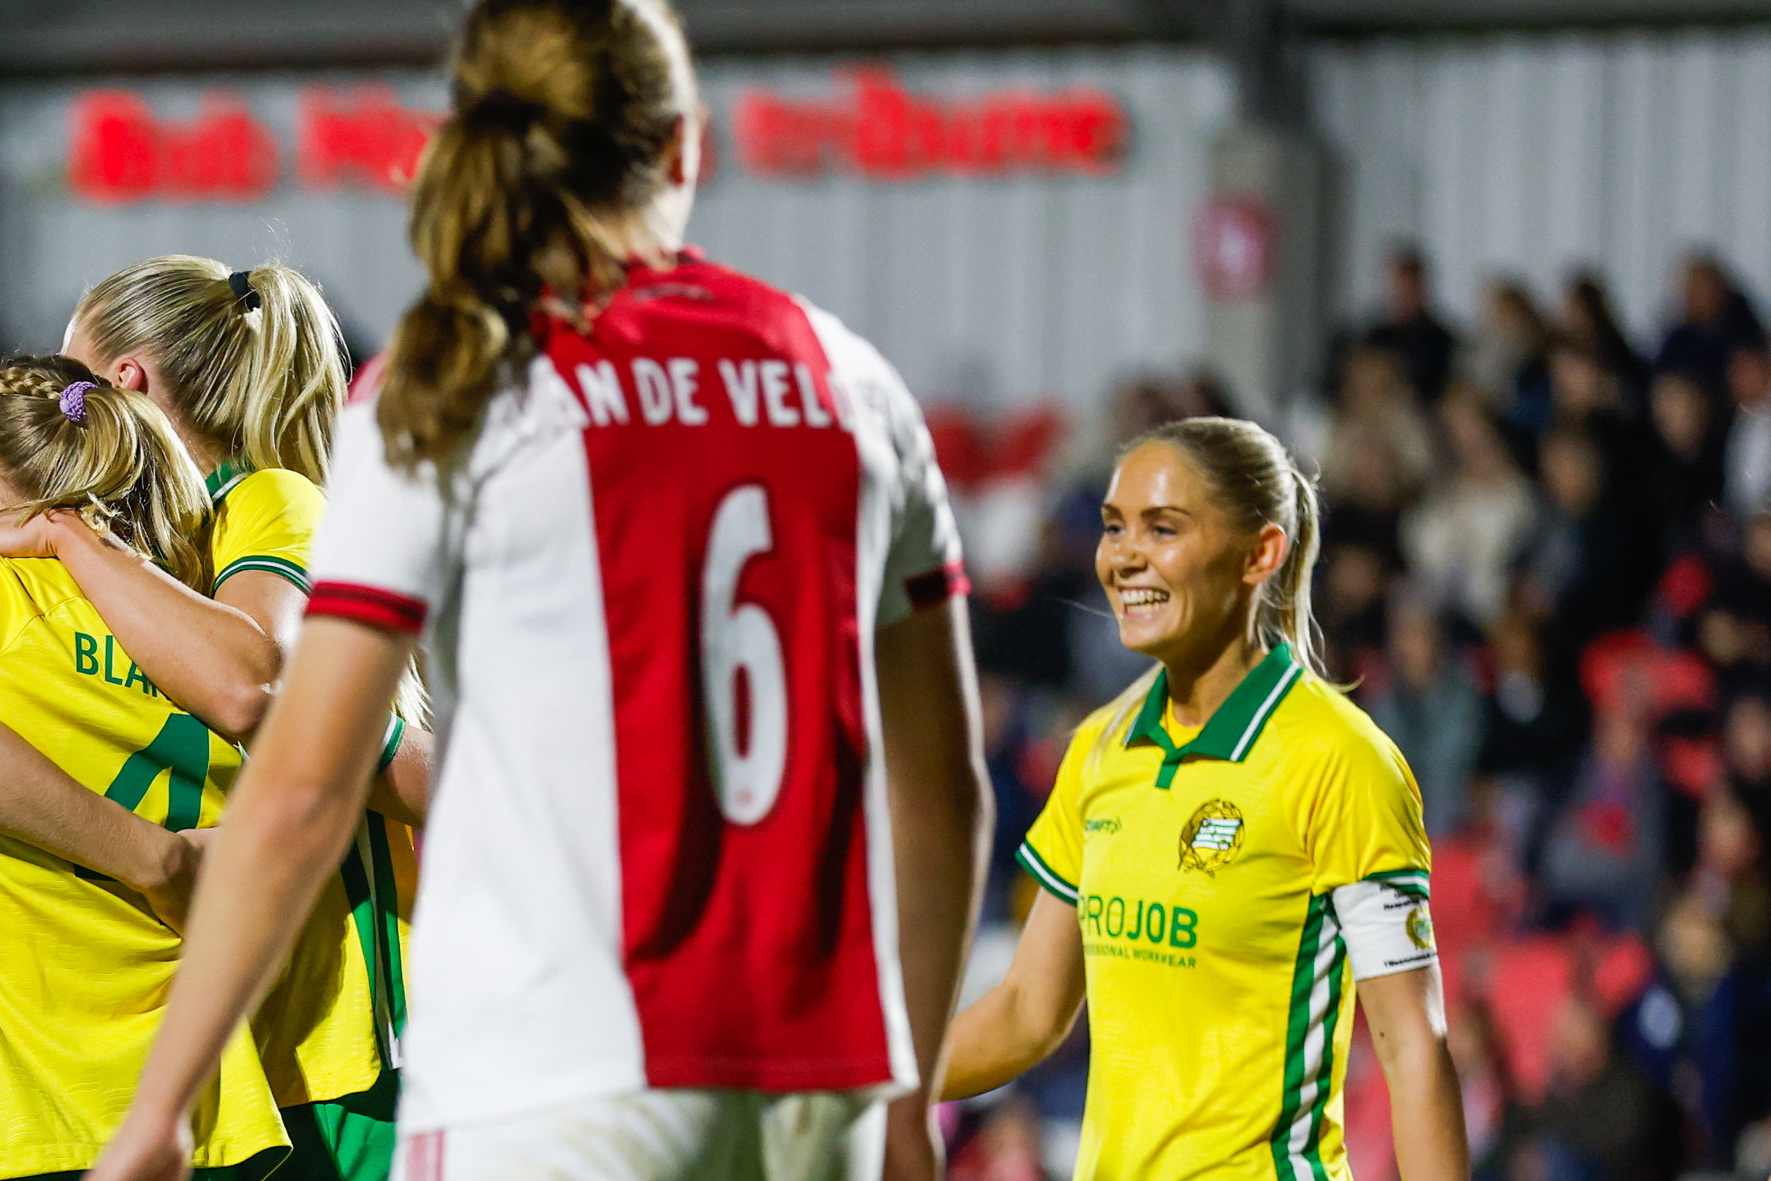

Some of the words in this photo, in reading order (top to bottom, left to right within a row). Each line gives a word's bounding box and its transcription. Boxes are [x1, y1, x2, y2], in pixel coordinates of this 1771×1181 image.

[631, 357, 709, 426] DE
[74, 631, 158, 698] BLA
[700, 484, 788, 826] 6
